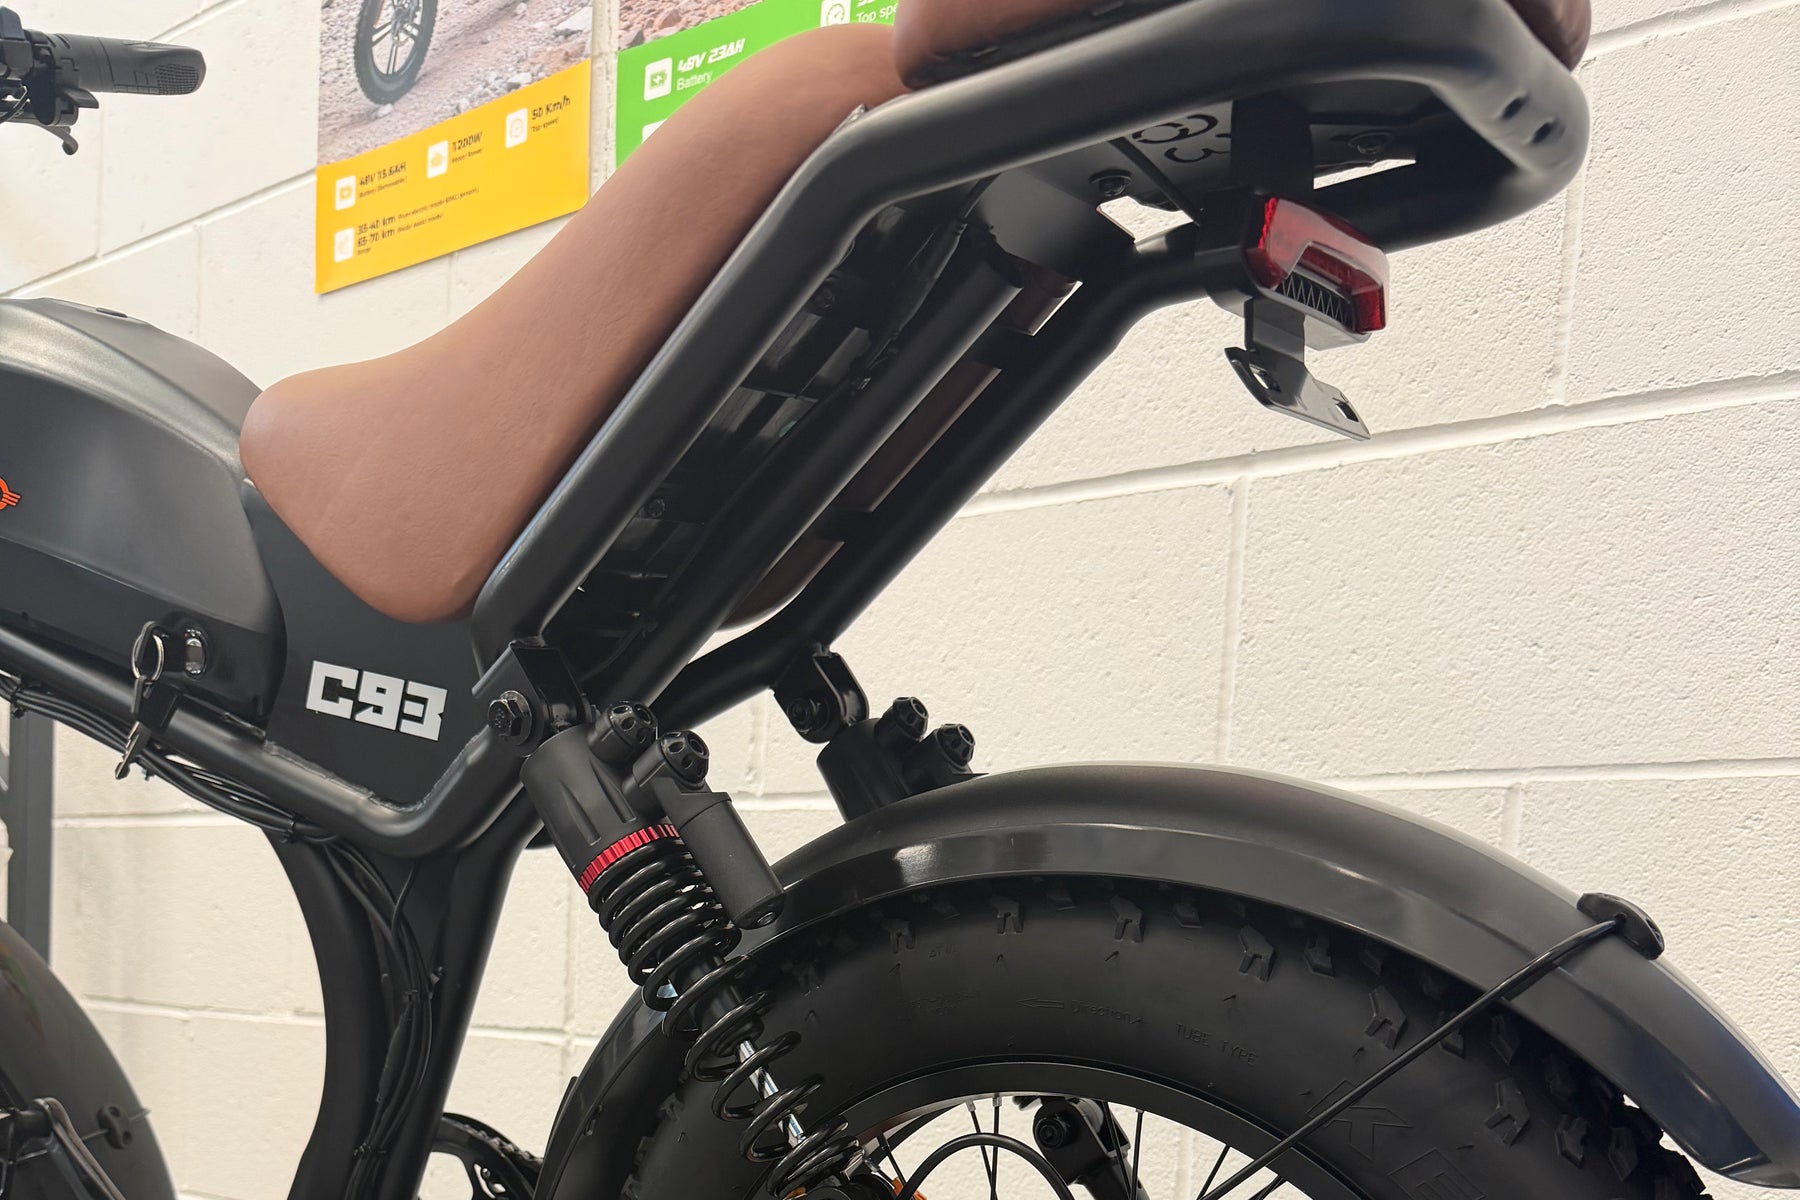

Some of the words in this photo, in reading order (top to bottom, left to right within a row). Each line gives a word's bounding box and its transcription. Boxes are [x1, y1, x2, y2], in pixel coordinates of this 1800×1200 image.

[677, 52, 706, 73] 48V
[707, 38, 746, 64] 23AH
[676, 71, 713, 91] Battery
[451, 132, 484, 152] 1200W
[305, 660, 448, 742] C93
